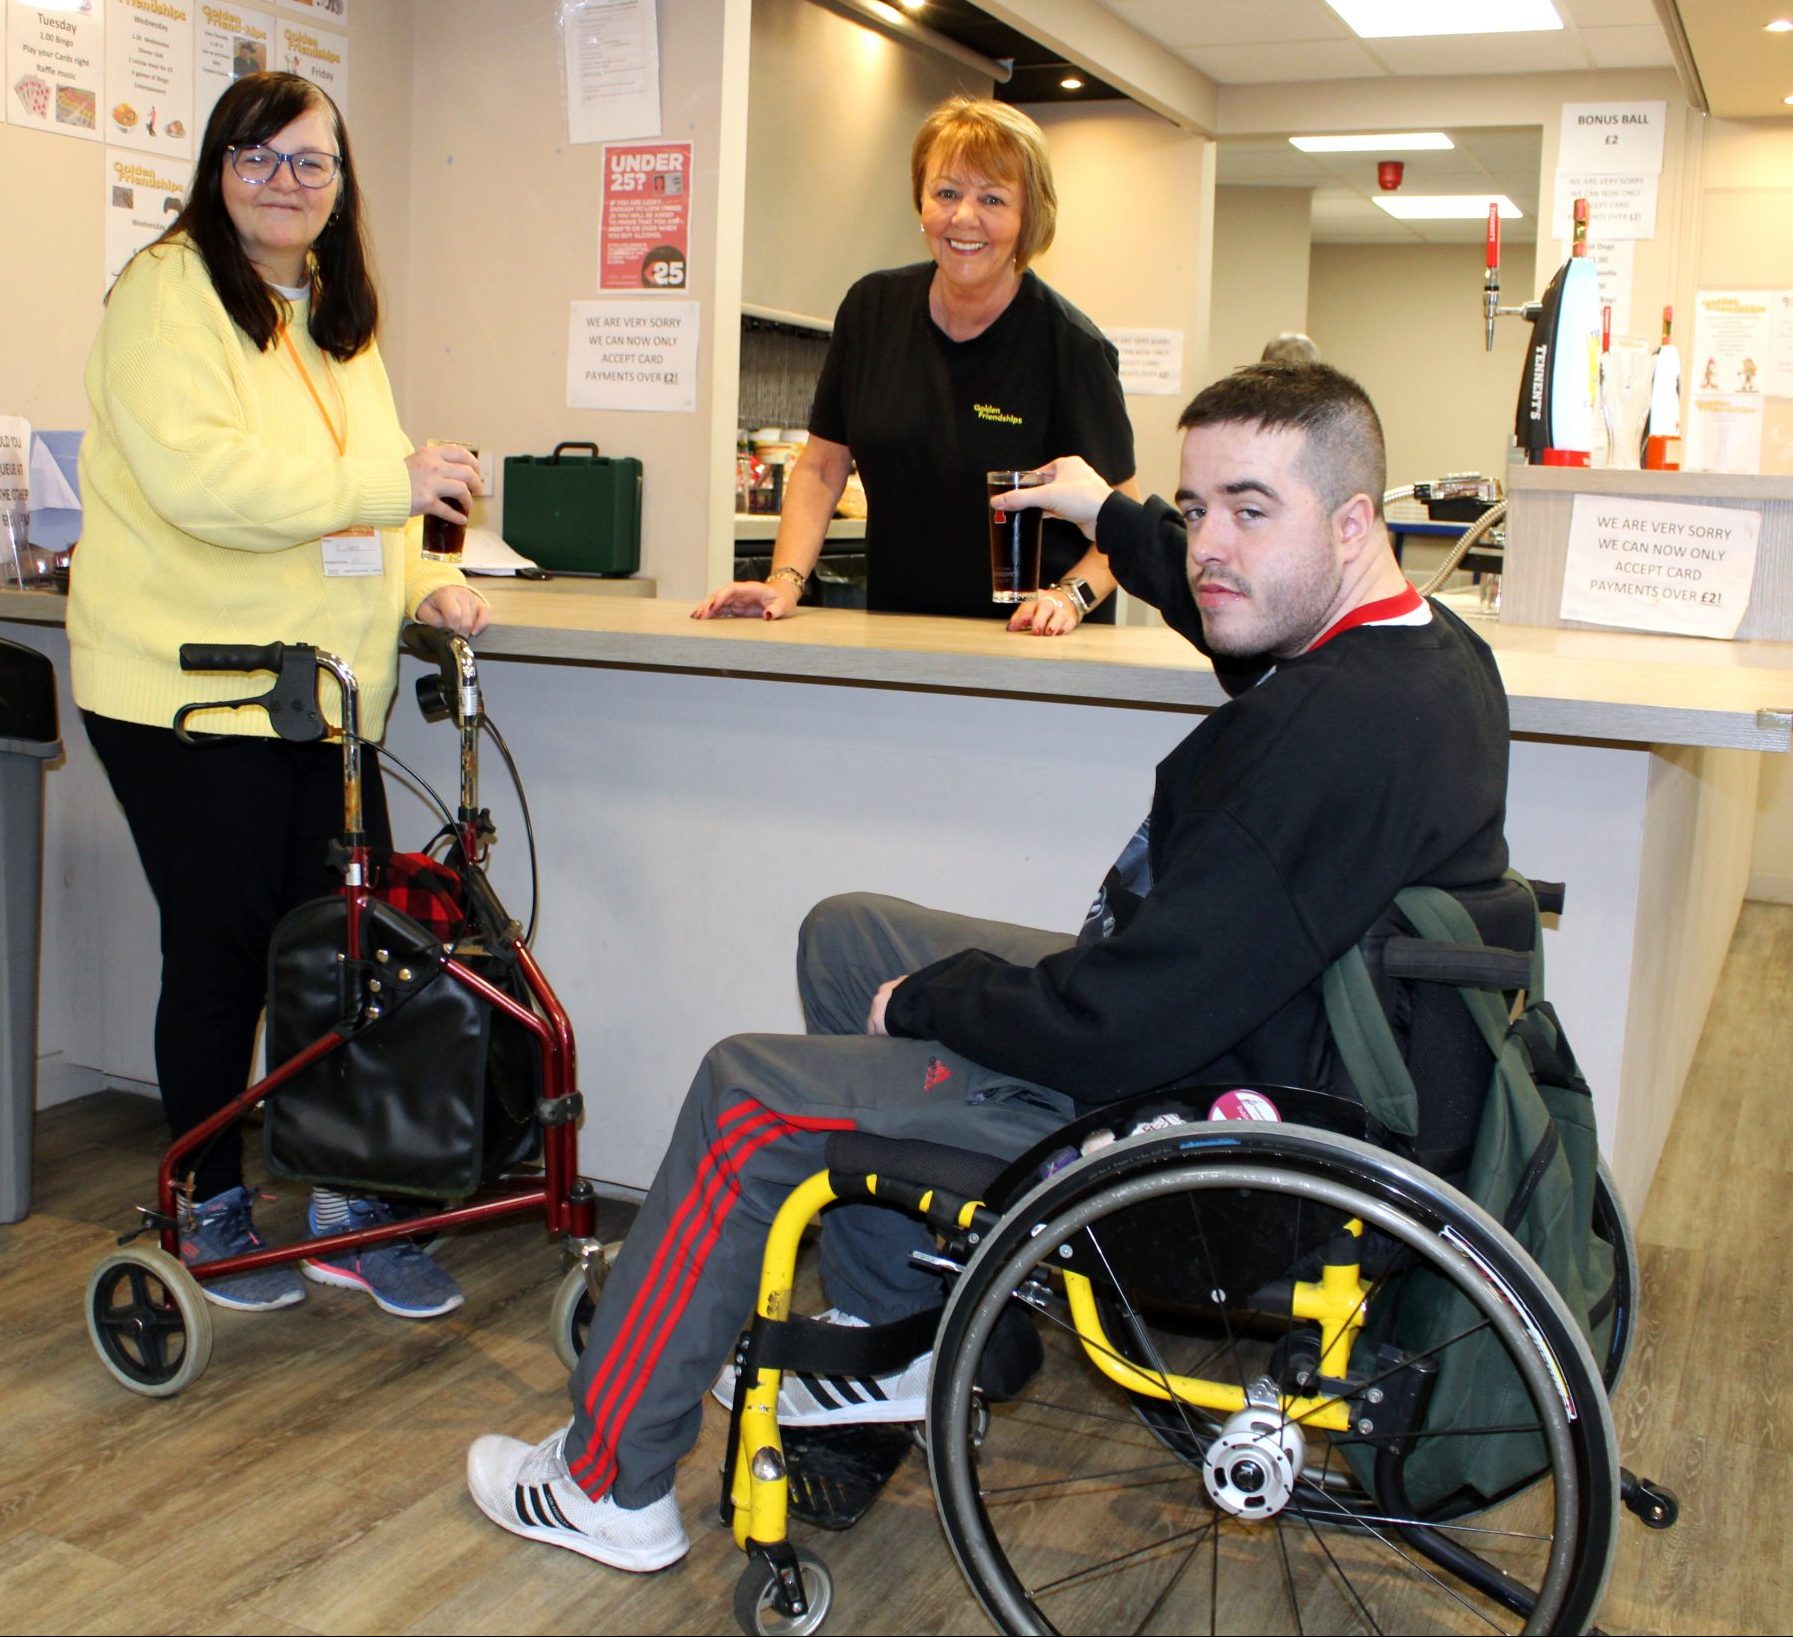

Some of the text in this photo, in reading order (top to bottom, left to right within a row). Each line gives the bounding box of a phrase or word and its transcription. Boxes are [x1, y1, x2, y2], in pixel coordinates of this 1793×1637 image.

[38, 12, 77, 35] Tuesday
[55, 35, 74, 48] Bingo
[285, 29, 318, 50] Golden
[23, 43, 90, 67] Play your Cards right
[36, 63, 77, 80] Raffle music
[312, 66, 334, 83] Friday
[1578, 114, 1648, 125] BONUS BALL
[1605, 135, 1619, 145] £2
[113, 161, 156, 178] Golden
[610, 153, 684, 172] UNDER
[118, 173, 184, 193] Friendships
[610, 173, 647, 192] 25?
[654, 261, 684, 285] 25
[586, 318, 681, 328] WE ARE VERY SORRY
[589, 336, 678, 346] WE CAN NOW ONLY
[601, 353, 663, 364] ACCEPT CARD
[585, 371, 678, 385] PAYMENTS OVER £2!
[1529, 344, 1548, 421] TENNENT'S
[974, 404, 1001, 414] Golden
[978, 411, 1023, 425] Friendships
[1597, 516, 1732, 540] WE ARE VERY SORRY
[1598, 538, 1726, 562] WE CAN NOW ONLY
[1615, 561, 1702, 581] ACCEPT CARD
[1590, 579, 1722, 607] PAYMENTS OVER £2!
